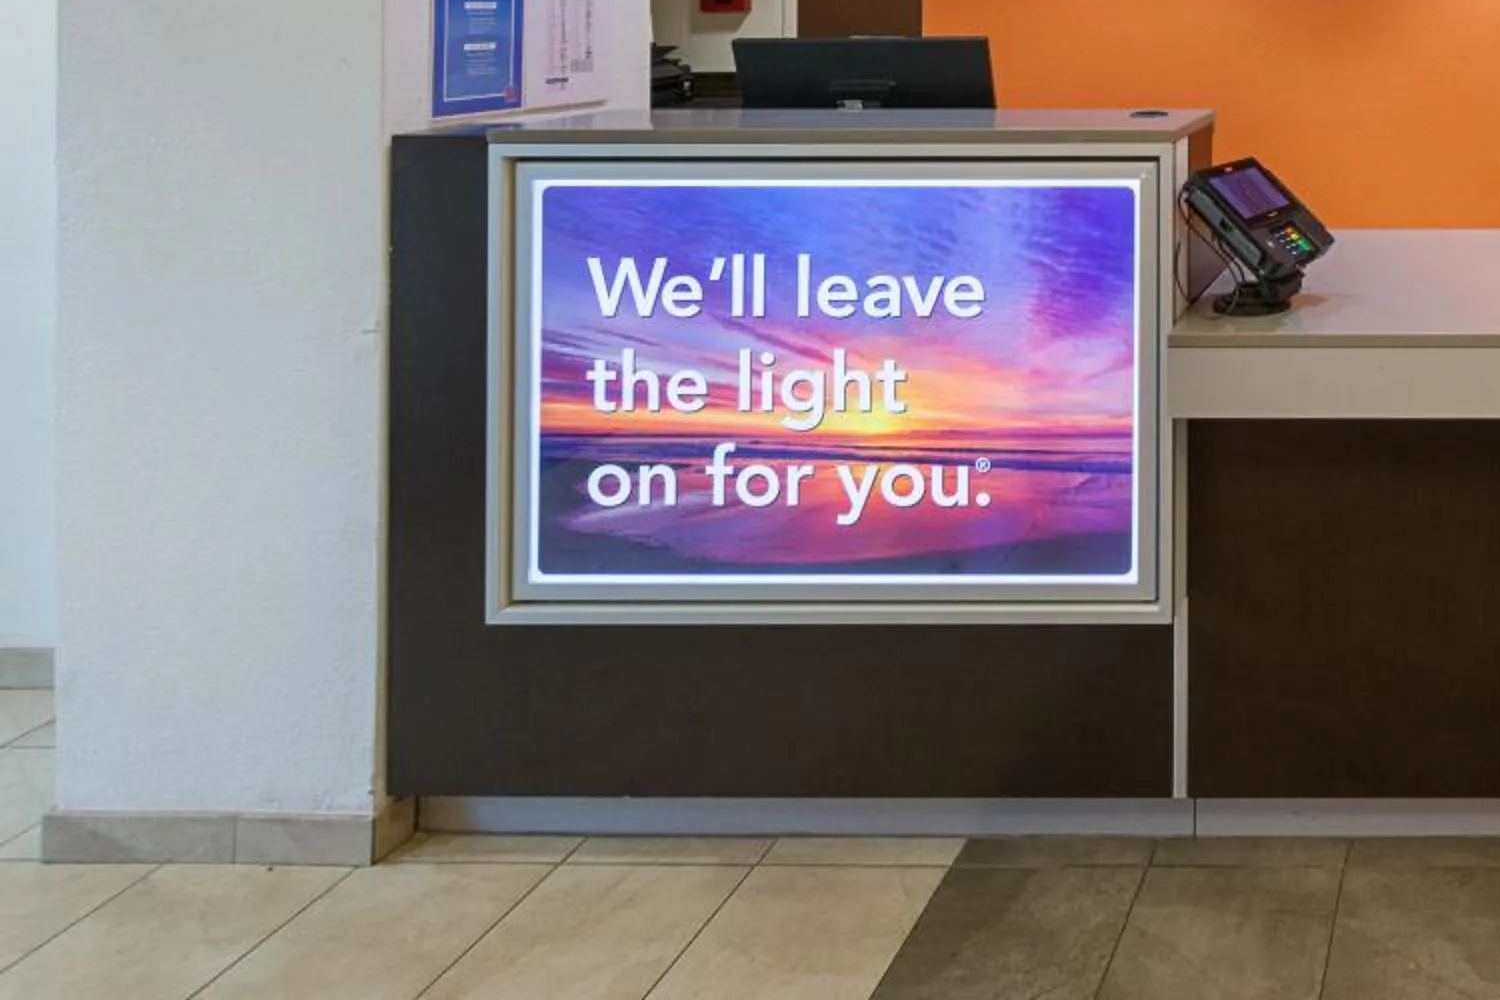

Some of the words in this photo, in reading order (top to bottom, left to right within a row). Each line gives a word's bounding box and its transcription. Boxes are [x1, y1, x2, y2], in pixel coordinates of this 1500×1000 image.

[586, 253, 766, 319] We'll
[796, 253, 987, 319] leave
[585, 347, 708, 414] the
[737, 347, 909, 432] light
[586, 463, 678, 508] on
[704, 443, 815, 508] for
